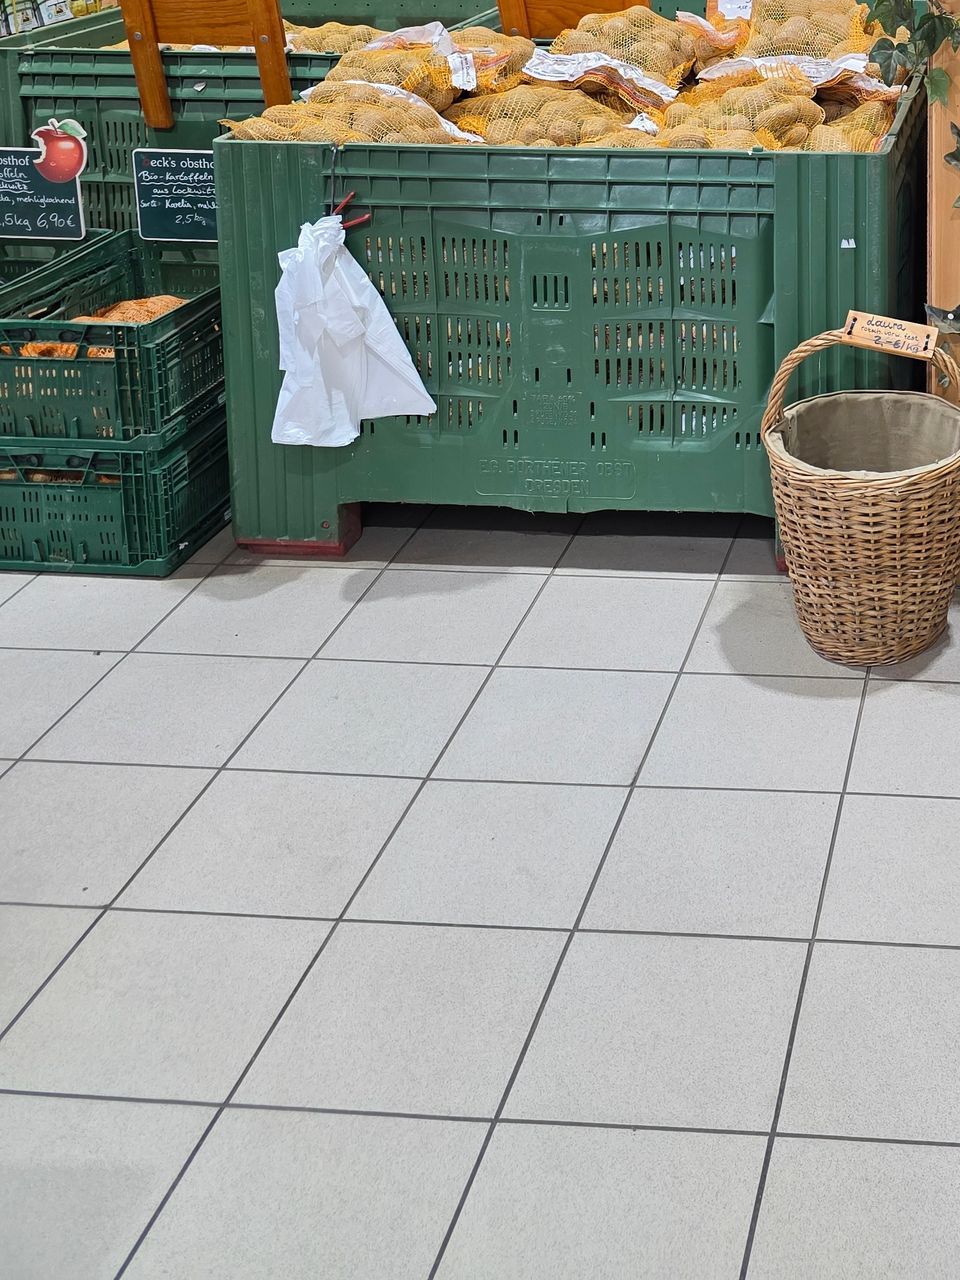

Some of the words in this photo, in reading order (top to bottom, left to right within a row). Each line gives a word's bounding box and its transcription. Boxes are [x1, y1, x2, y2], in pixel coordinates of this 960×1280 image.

[143, 157, 176, 168] beck's
[138, 170, 214, 183] Bio-Kartoffeln
[152, 187, 170, 195] aus
[37, 213, 76, 228] 6,90€
[867, 316, 906, 331] Laura
